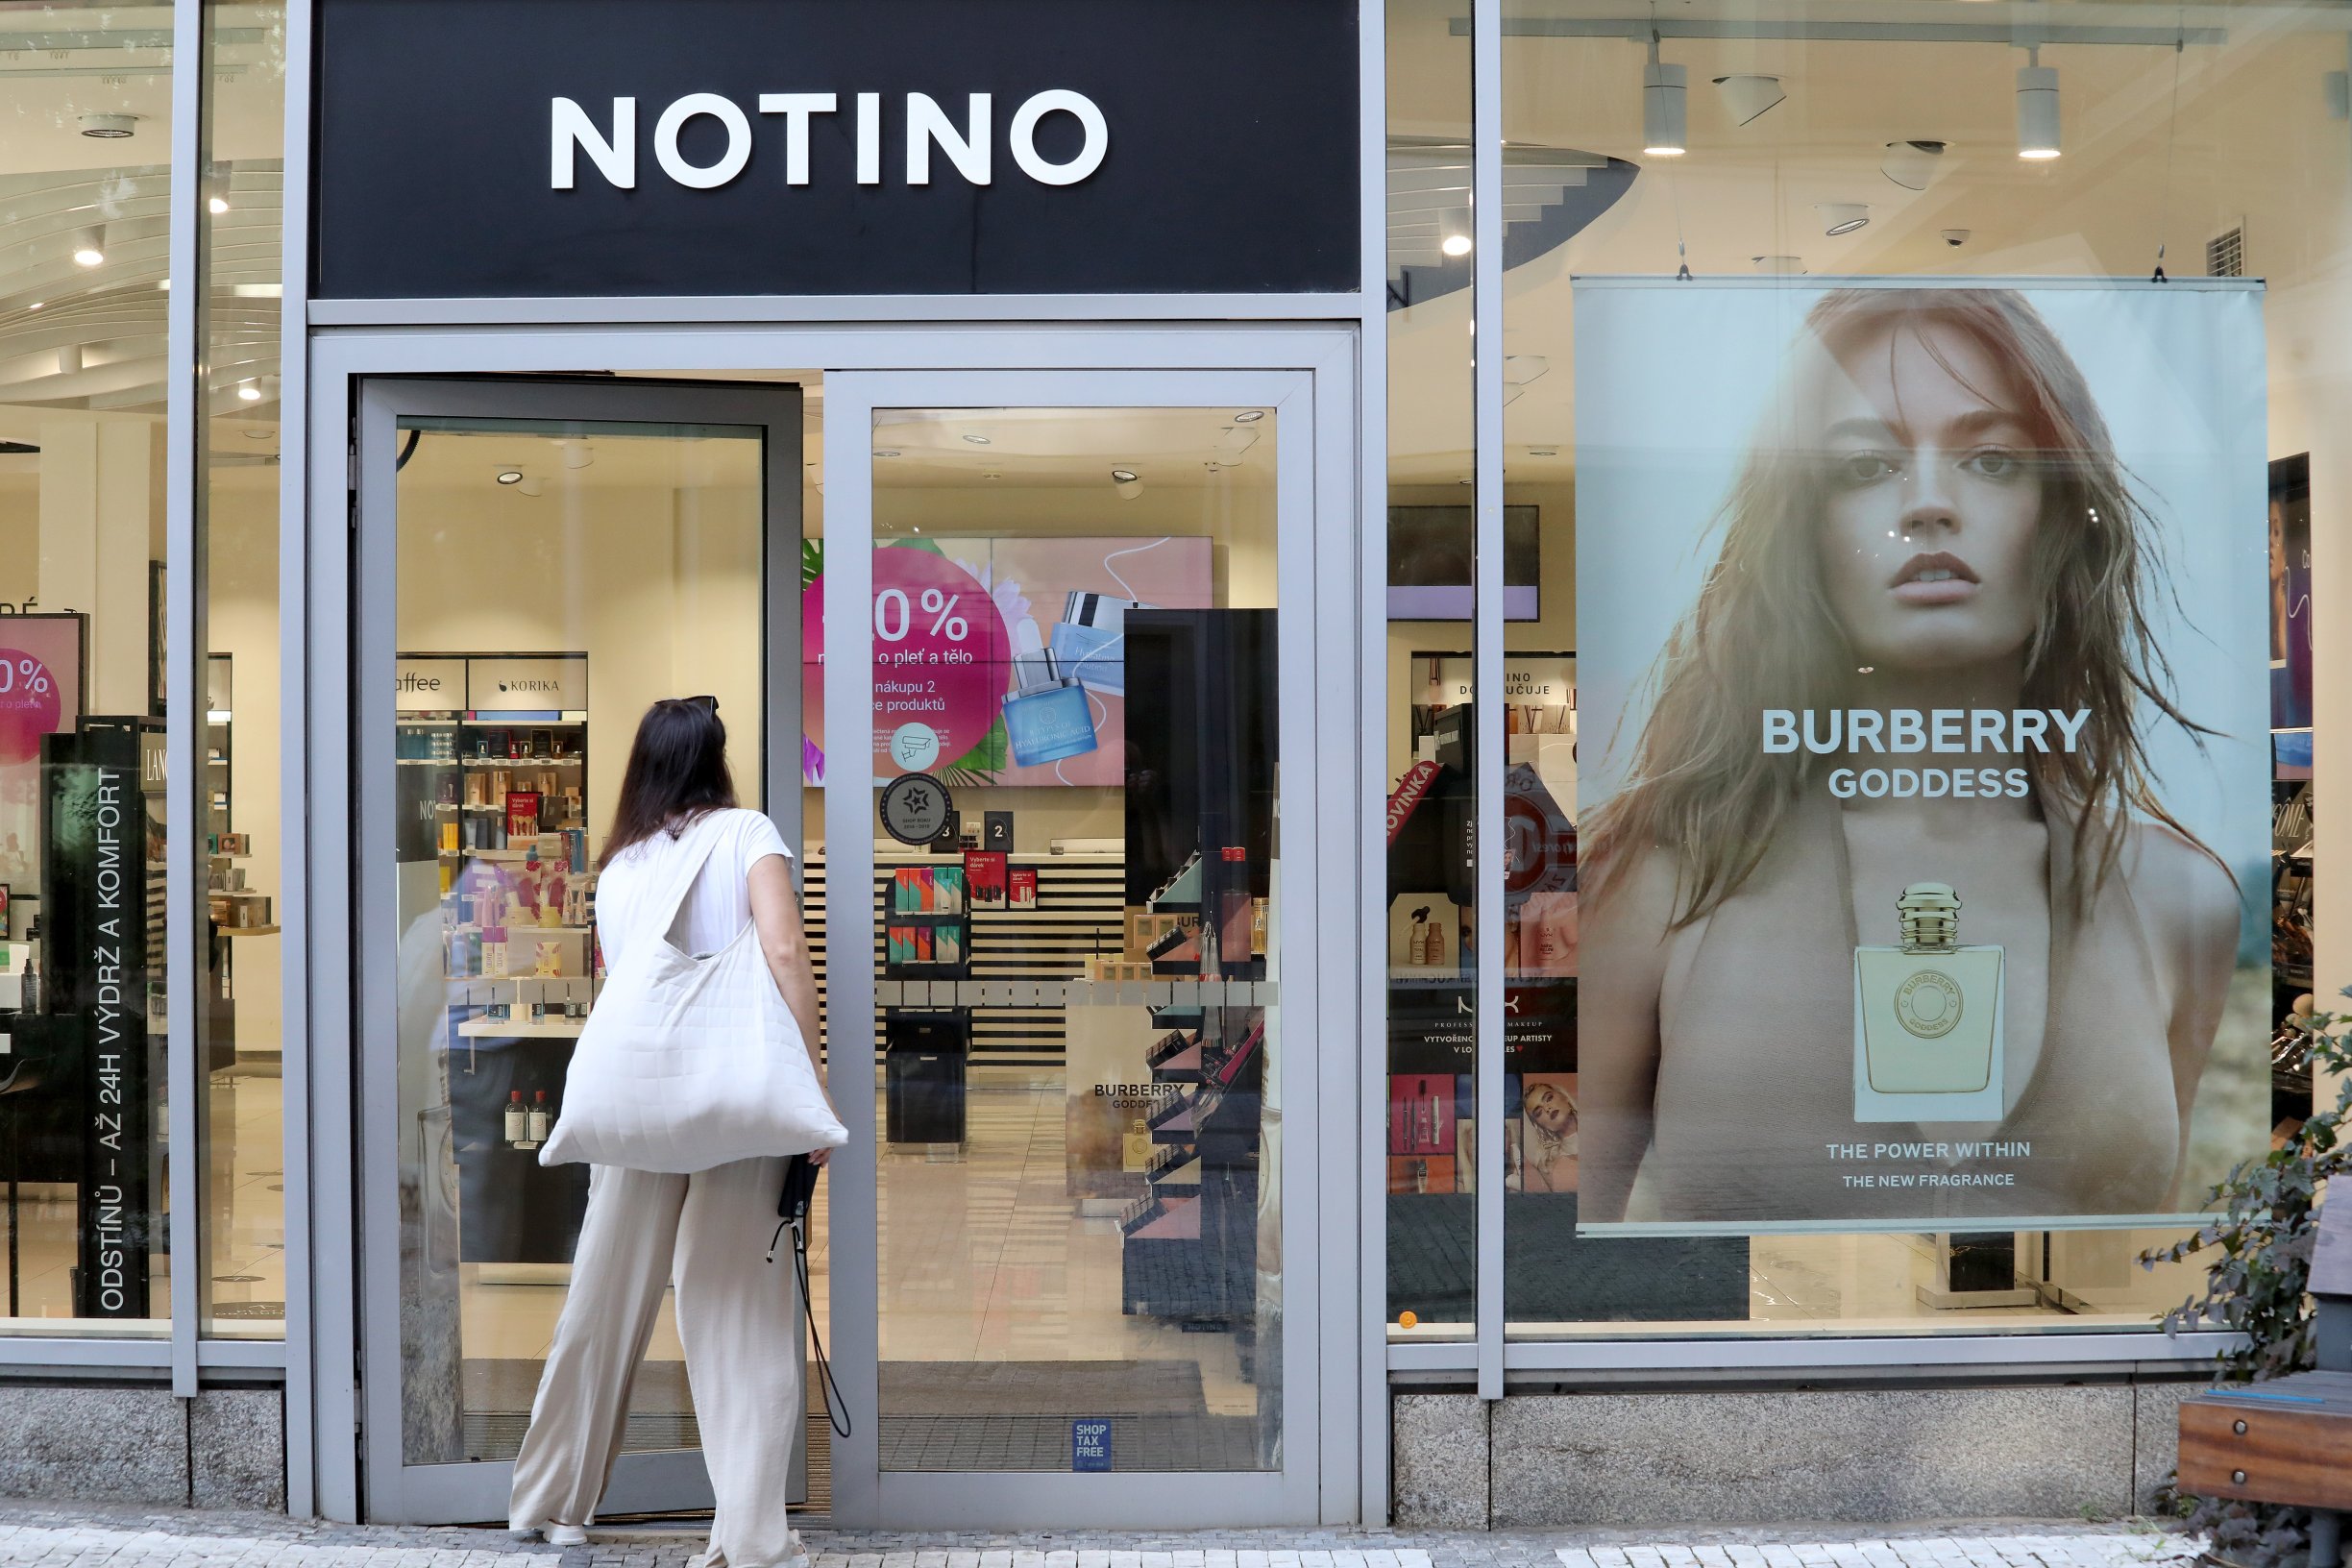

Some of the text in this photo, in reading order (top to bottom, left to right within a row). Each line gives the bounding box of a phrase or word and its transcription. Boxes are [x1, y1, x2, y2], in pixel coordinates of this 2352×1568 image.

[551, 89, 1108, 189] NOTINO
[874, 588, 968, 642] 0 %
[878, 649, 973, 668] o pleť a tělo
[19, 659, 48, 693] %
[1506, 673, 1531, 682] INO
[511, 680, 559, 692] KORIKA
[875, 681, 936, 696] nákupu 2
[887, 698, 945, 713] produktů
[1762, 709, 2092, 754] BURBERRY
[1828, 768, 2029, 798] GODDESS
[1386, 766, 1433, 836] OVINKA
[97, 767, 121, 909] KOMFORT
[994, 825, 1003, 838] 2
[98, 918, 120, 938] A
[1902, 974, 1956, 996] BURBERRY
[93, 946, 121, 1045] VÝDRŽ
[1908, 1018, 1949, 1032] GODDESS
[99, 1054, 121, 1105] 24H
[1094, 1084, 1185, 1096] BURBERRY
[1113, 1100, 1152, 1109] GODDE
[94, 1113, 122, 1151] AŽ
[1826, 1141, 2030, 1159] THE POWER WITHIN
[1843, 1174, 2014, 1188] THE NEW FRAGRANCE
[94, 1185, 124, 1311] ODSTÍNŮ
[1077, 1425, 1107, 1435] SHOP
[1077, 1436, 1099, 1446] TAX
[1077, 1447, 1104, 1458] FREE
